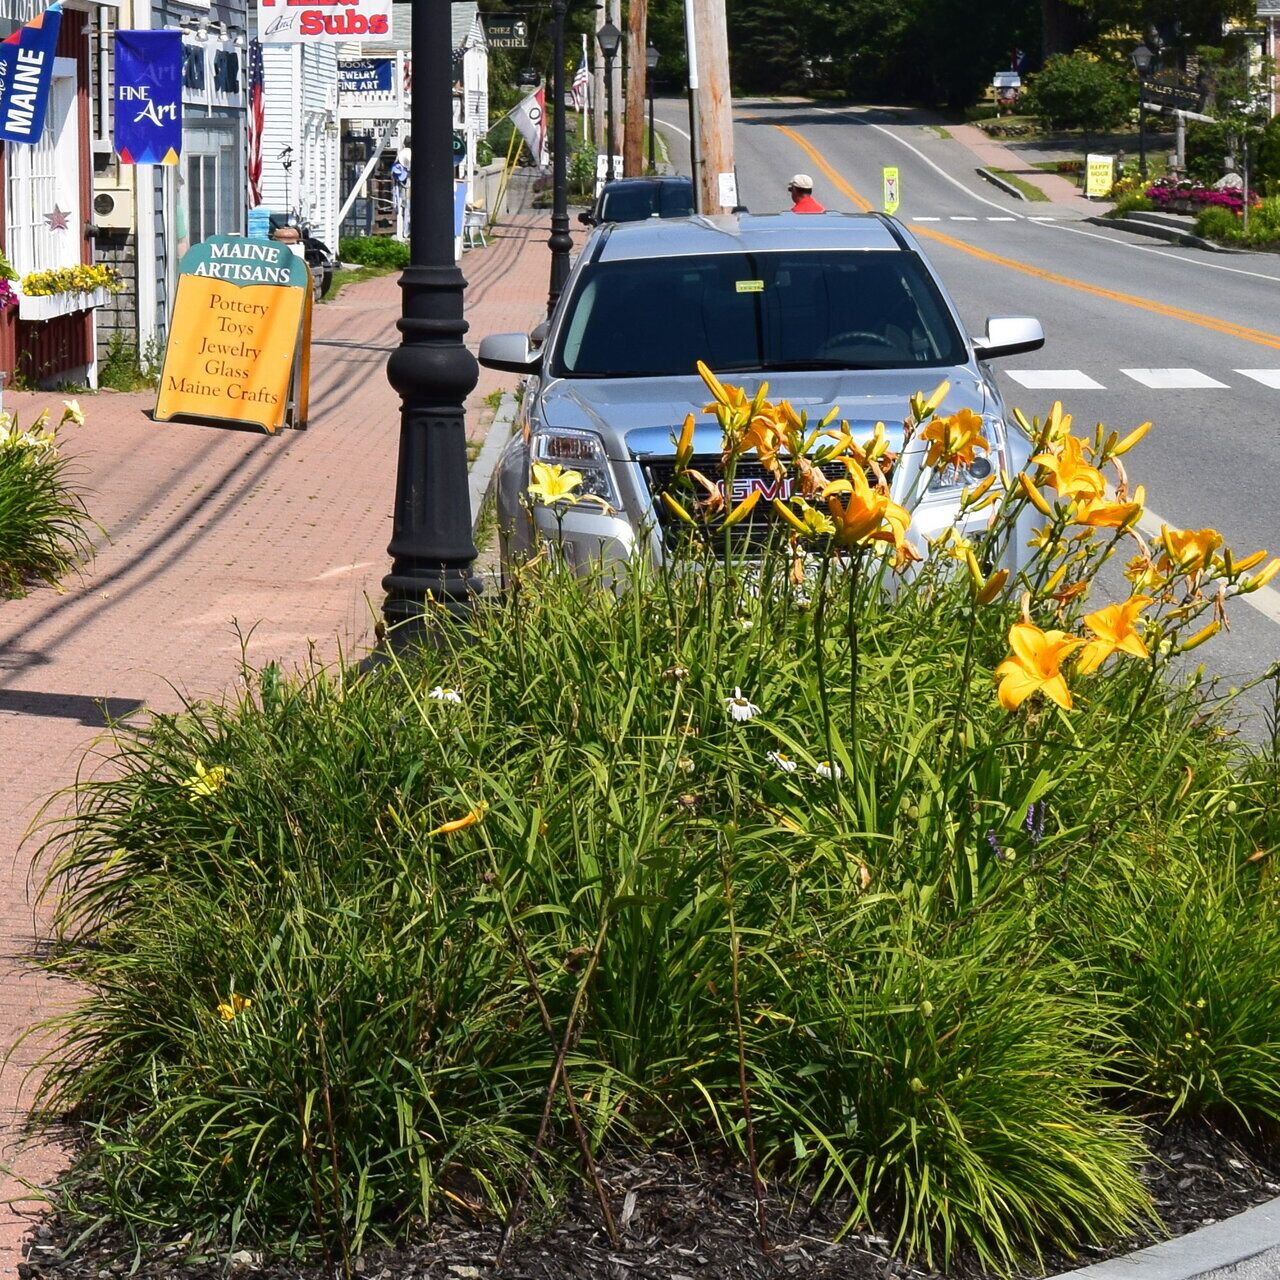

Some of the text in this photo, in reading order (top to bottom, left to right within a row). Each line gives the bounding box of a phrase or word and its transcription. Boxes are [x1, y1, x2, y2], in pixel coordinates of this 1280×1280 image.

[300, 8, 389, 36] Subs
[488, 38, 528, 48] MICHEL
[4, 48, 45, 134] MAINE
[119, 85, 151, 101] FINE
[360, 80, 379, 90] ART
[133, 100, 177, 127] Art
[210, 243, 280, 263] MAINE
[195, 261, 290, 284] ARTISANS
[209, 294, 269, 316] Pottery
[217, 316, 254, 337] Toys
[198, 337, 261, 362] Jewelry
[204, 359, 250, 379] Glass
[168, 376, 279, 405] Maine Crafts
